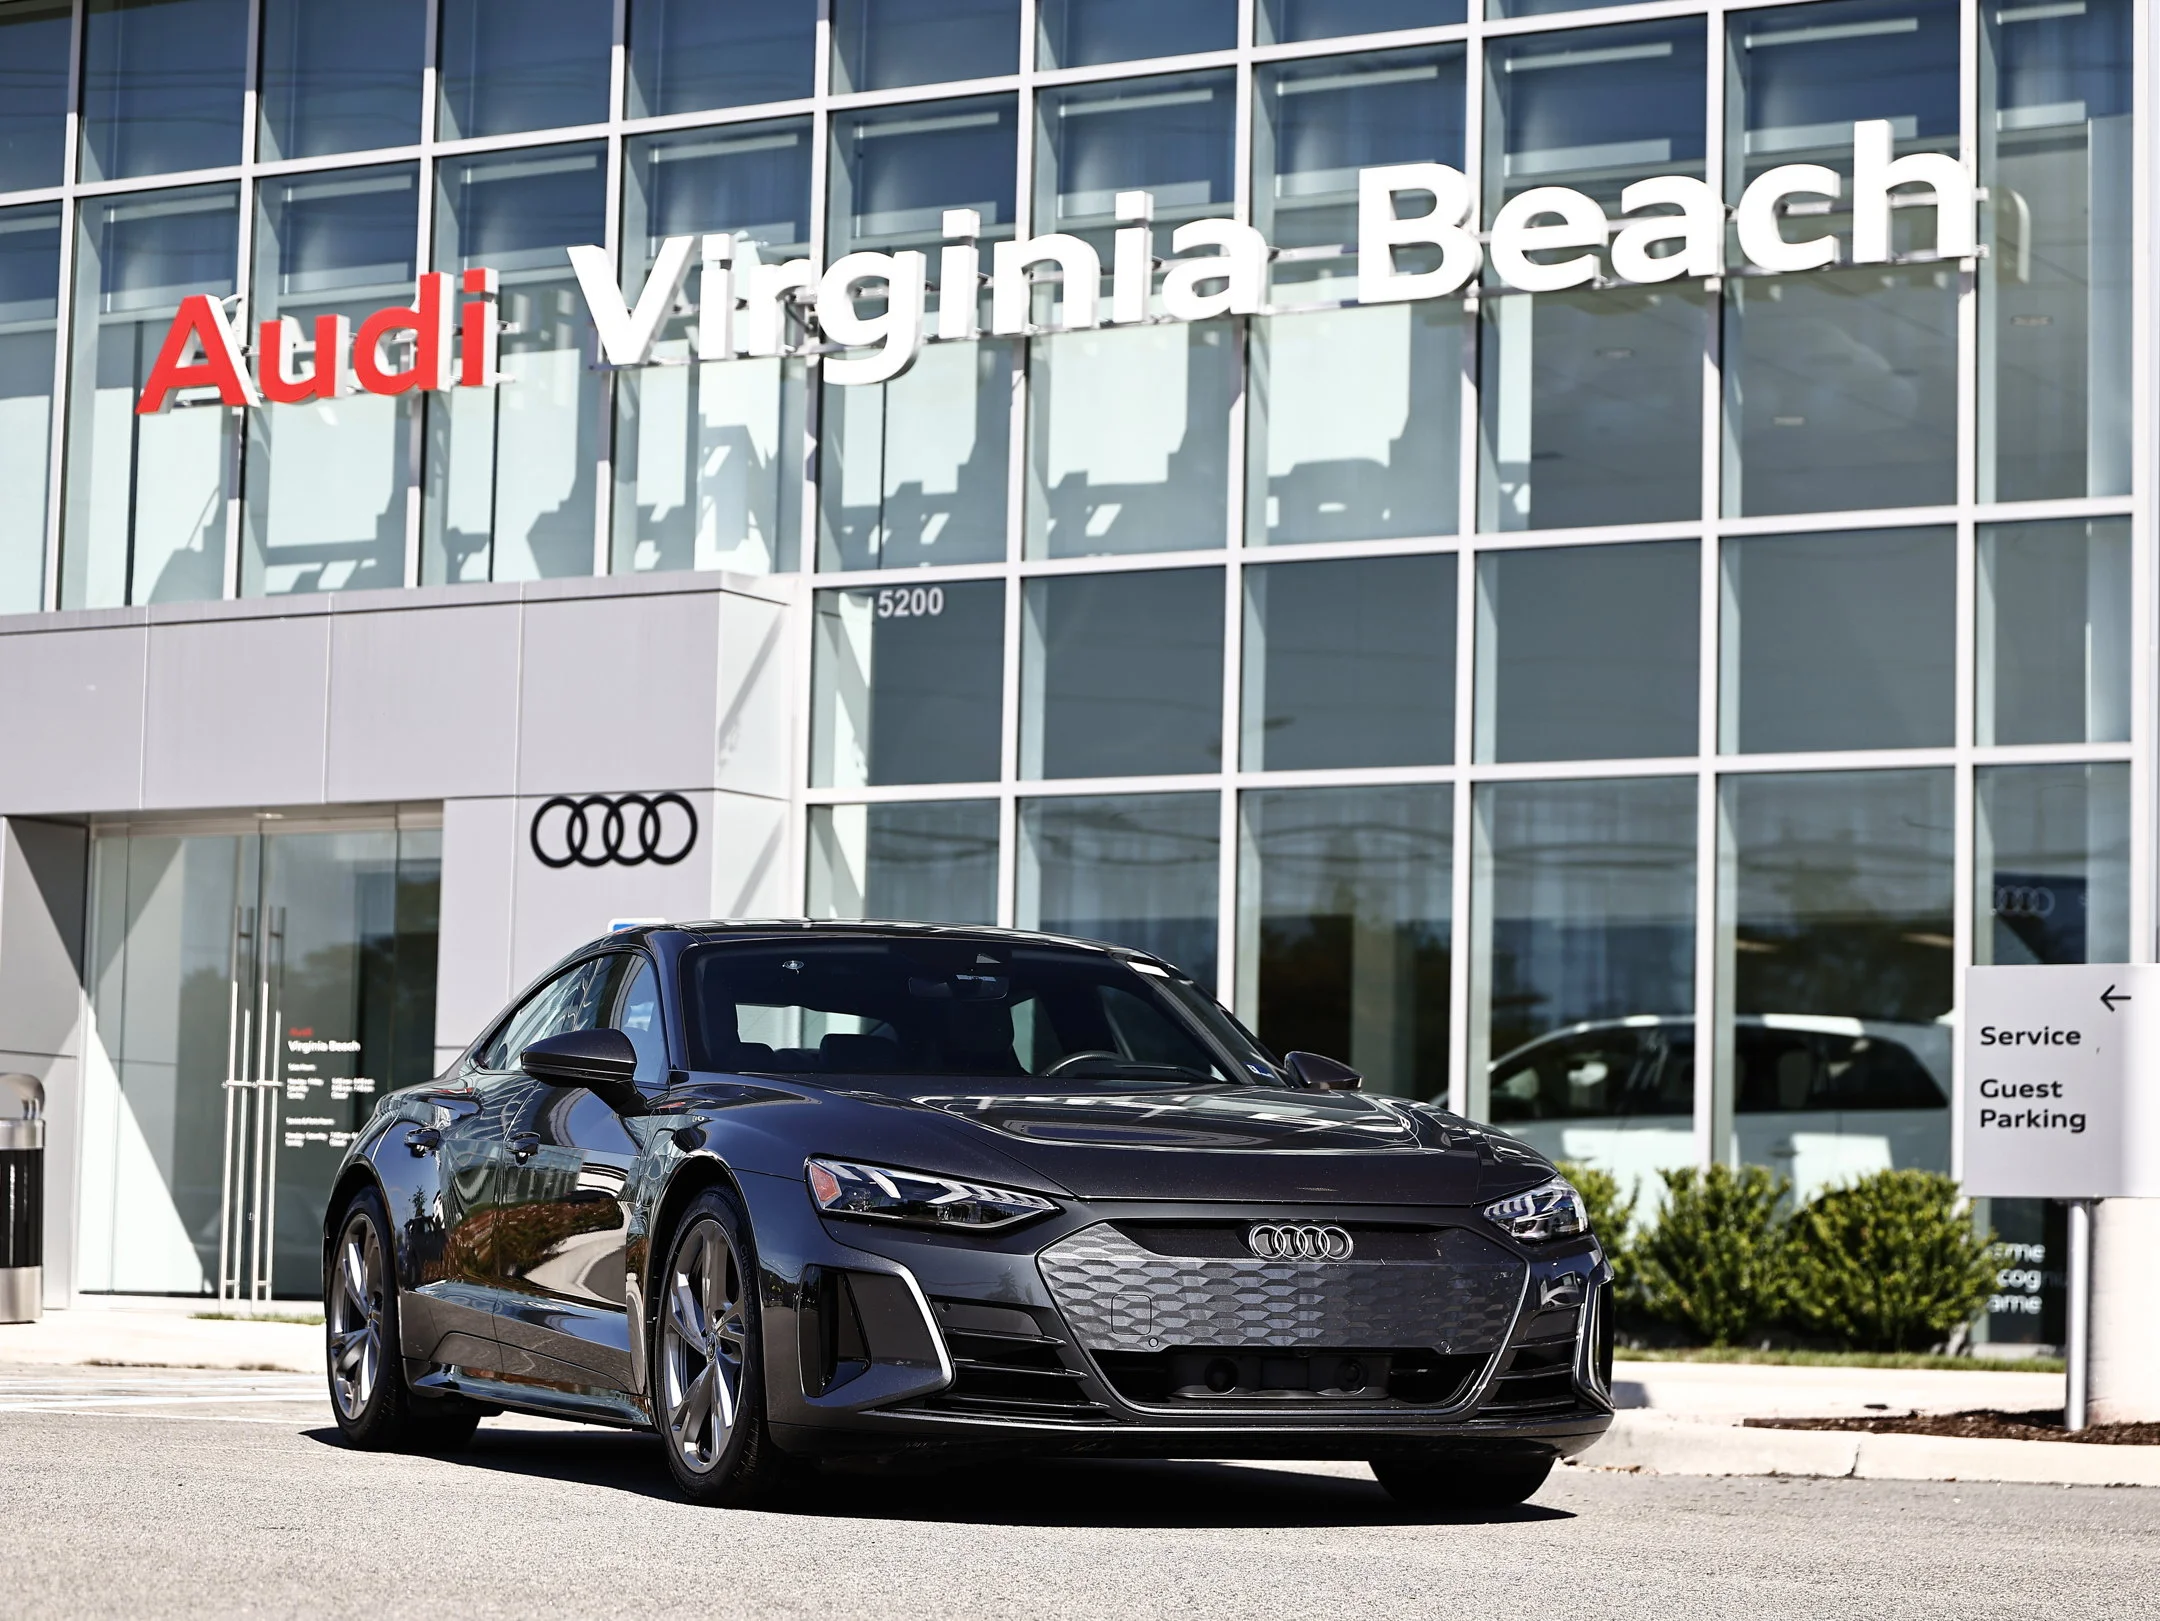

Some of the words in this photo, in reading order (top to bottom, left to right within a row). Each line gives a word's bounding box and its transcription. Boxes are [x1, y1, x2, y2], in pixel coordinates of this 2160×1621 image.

[135, 268, 497, 414] Audi
[567, 191, 1268, 385] Virginia
[1358, 119, 1977, 303] Beach
[878, 586, 944, 618] 5200
[328, 1040, 361, 1052] Beach
[1980, 1025, 2081, 1046] Service
[287, 1040, 328, 1054] Virginia
[1980, 1079, 2063, 1099] Guest
[1980, 1109, 2086, 1133] Parking
